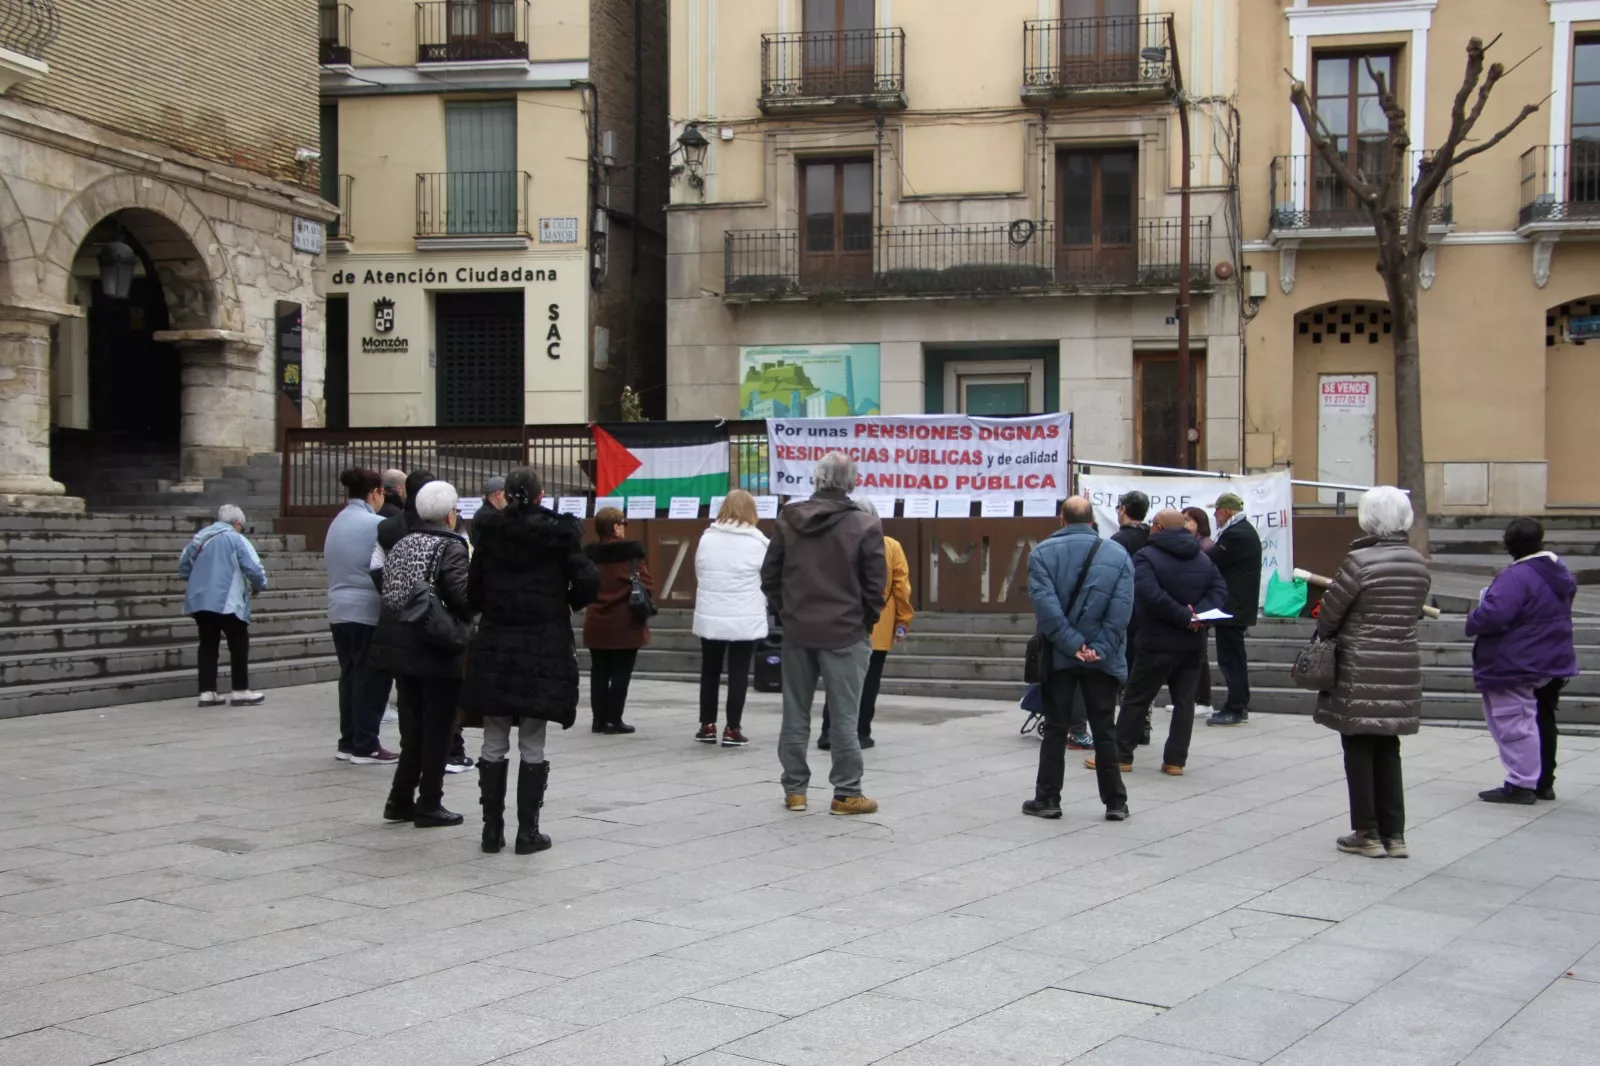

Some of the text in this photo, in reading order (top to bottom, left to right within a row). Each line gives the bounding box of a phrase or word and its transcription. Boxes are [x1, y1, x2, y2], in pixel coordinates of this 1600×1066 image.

[552, 220, 574, 230] CALLE
[544, 230, 575, 240] MAYOR
[332, 266, 558, 284] de Atención Ciudadana
[362, 336, 409, 347] Monzón
[1324, 382, 1367, 393] SE VENDE
[774, 423, 1060, 441] Por unas PENSIONES DIGNAS
[894, 446, 983, 465] PÚBLICAS
[987, 455, 994, 468] y
[997, 453, 1012, 465] de
[1015, 450, 1059, 465] calidad
[777, 471, 803, 485] Por
[956, 472, 1057, 490] PÚBLICA
